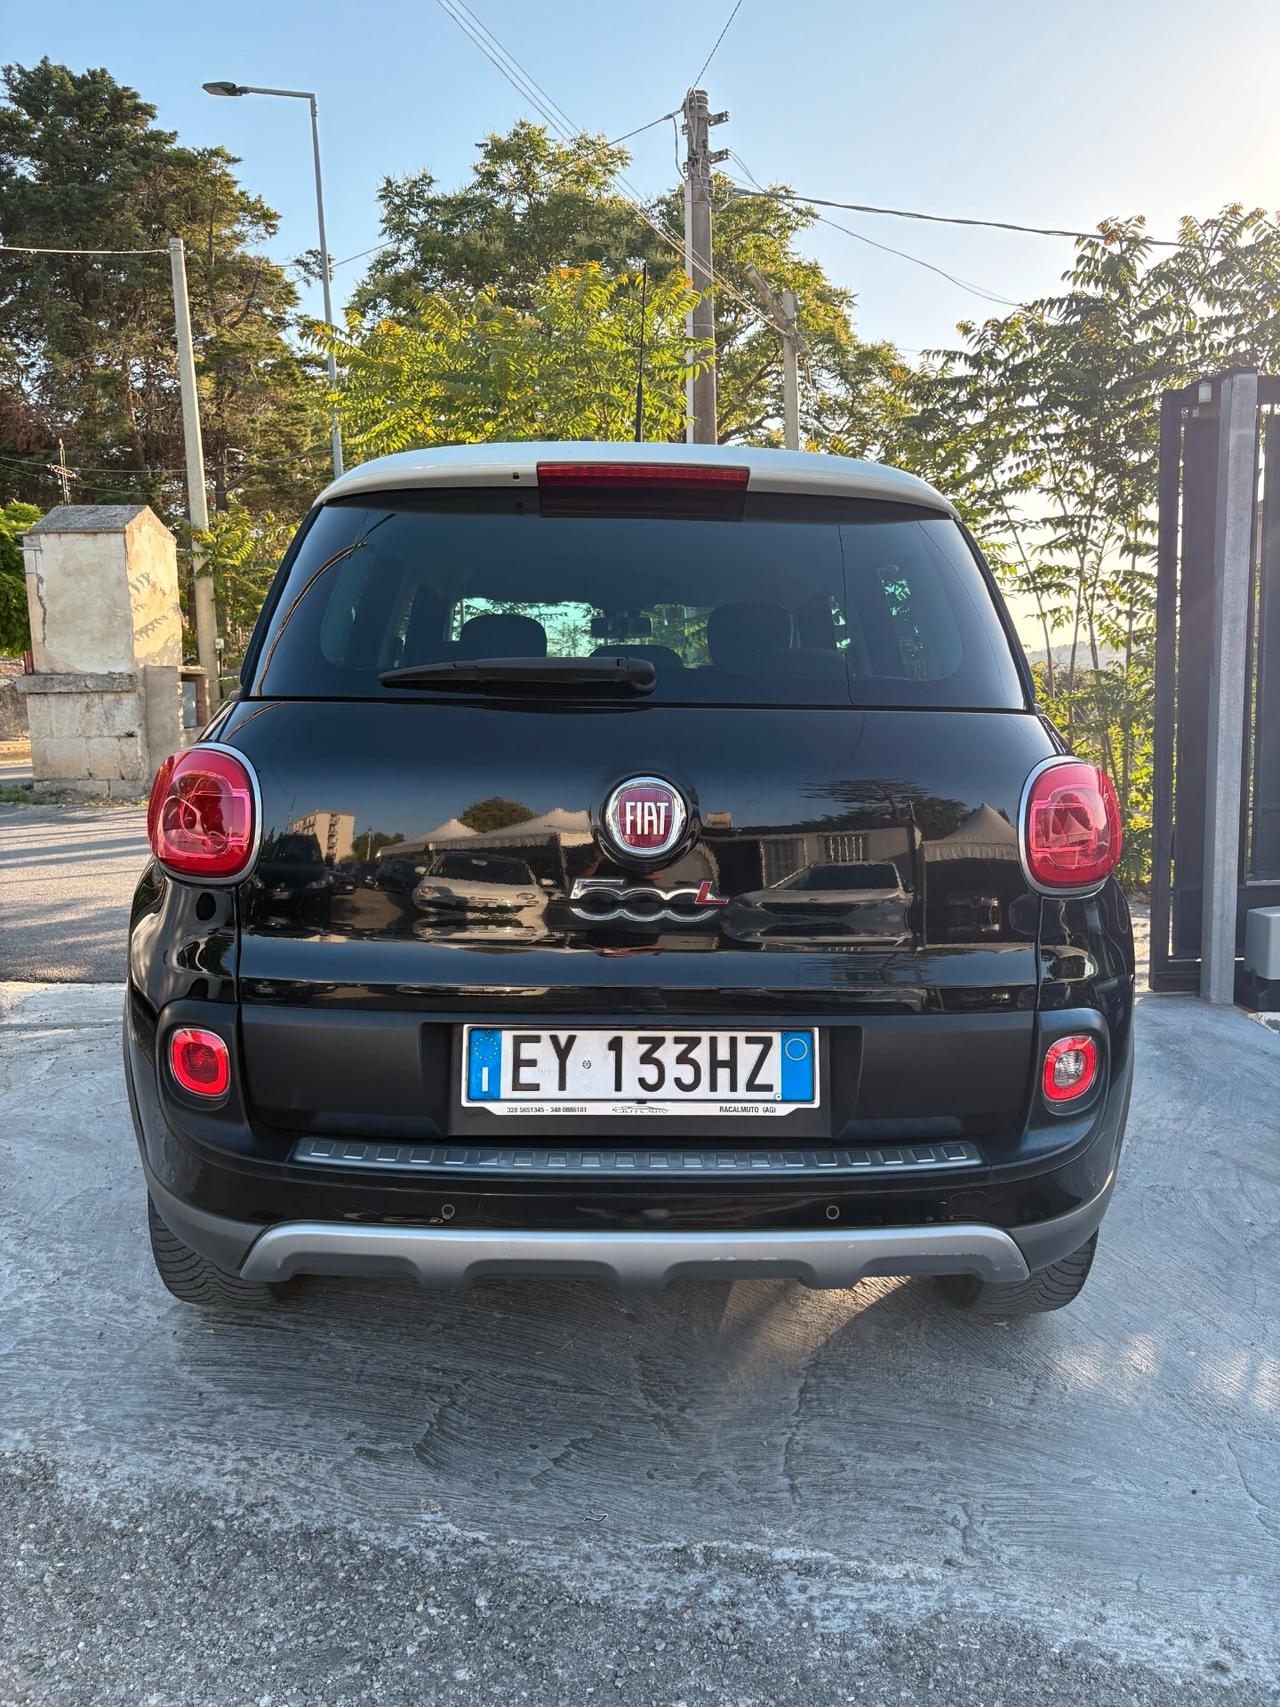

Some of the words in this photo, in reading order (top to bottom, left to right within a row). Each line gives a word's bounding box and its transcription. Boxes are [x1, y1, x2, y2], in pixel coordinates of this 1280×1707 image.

[624, 801, 669, 835] FIAT
[569, 879, 729, 922] 500L
[481, 1066, 489, 1091] I
[511, 1035, 577, 1091] EY
[607, 1036, 774, 1092] 133HZ
